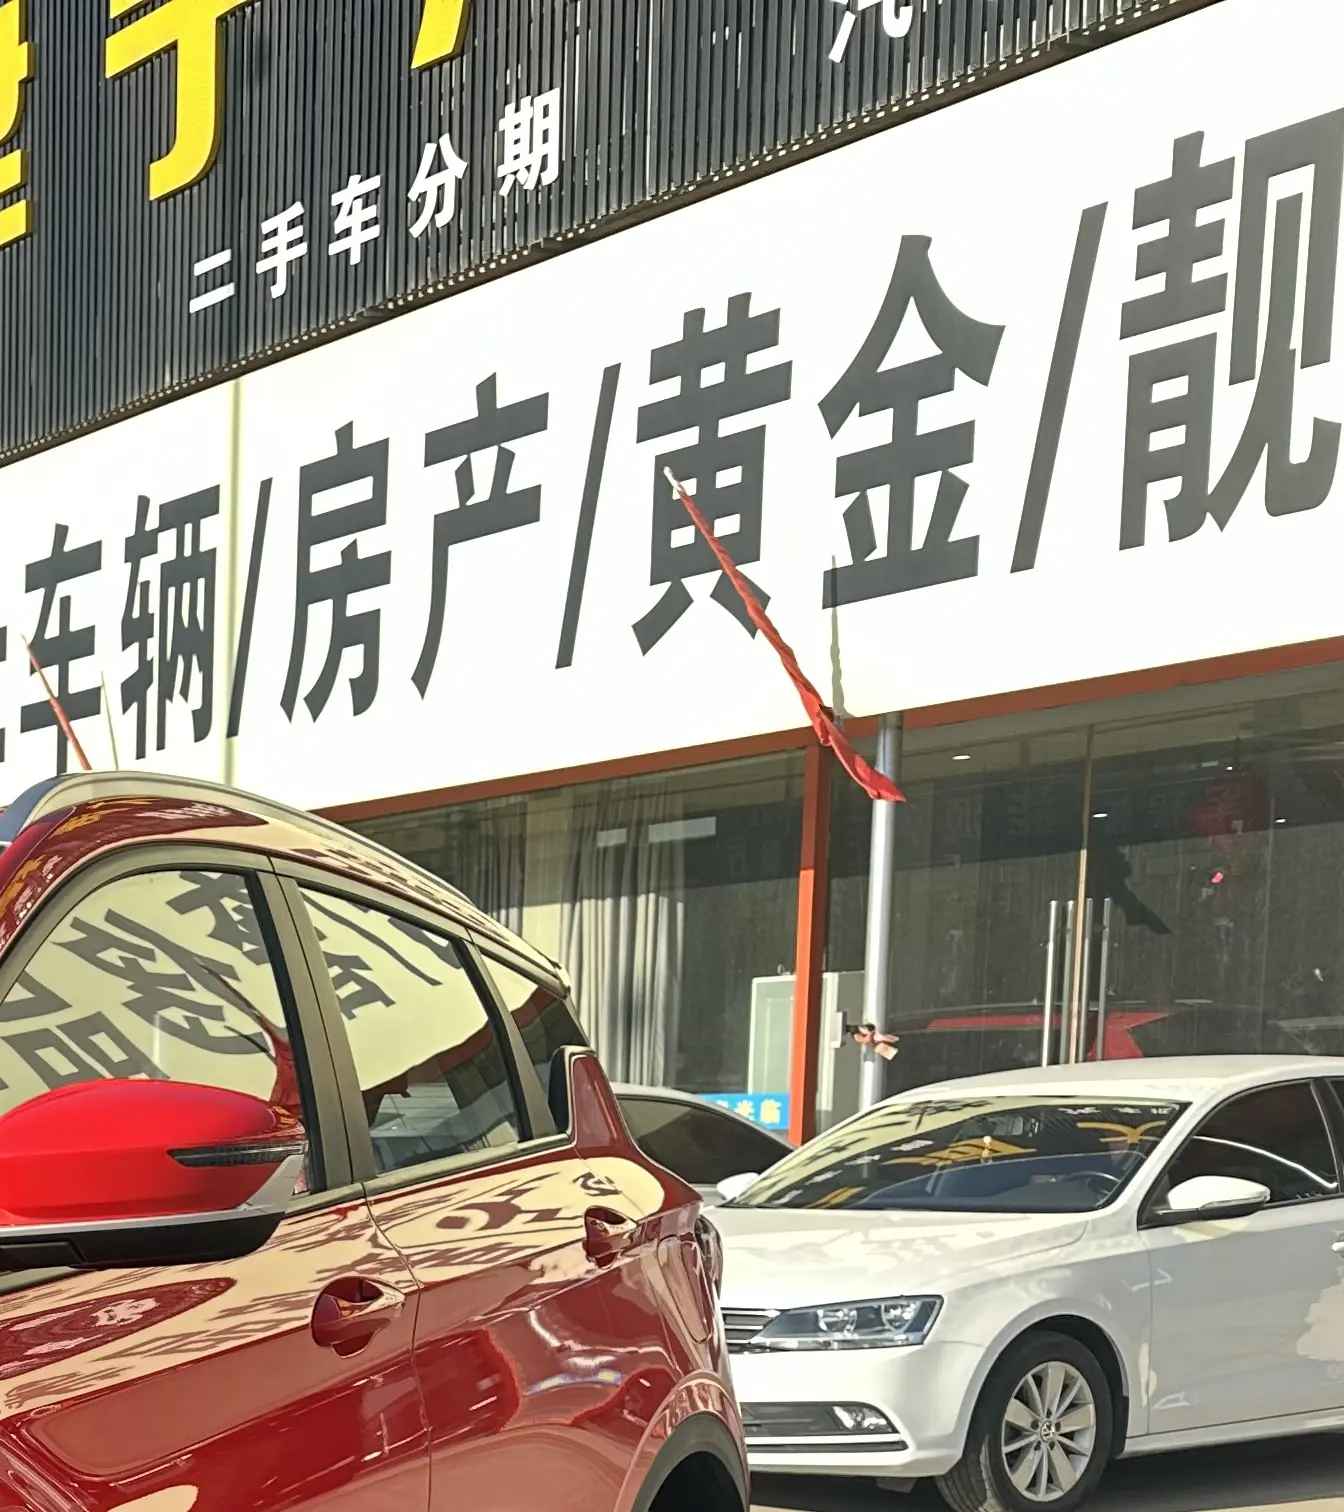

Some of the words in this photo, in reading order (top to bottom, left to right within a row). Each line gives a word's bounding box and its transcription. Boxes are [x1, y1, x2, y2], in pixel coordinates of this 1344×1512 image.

[189, 86, 562, 313] 二手车分期
